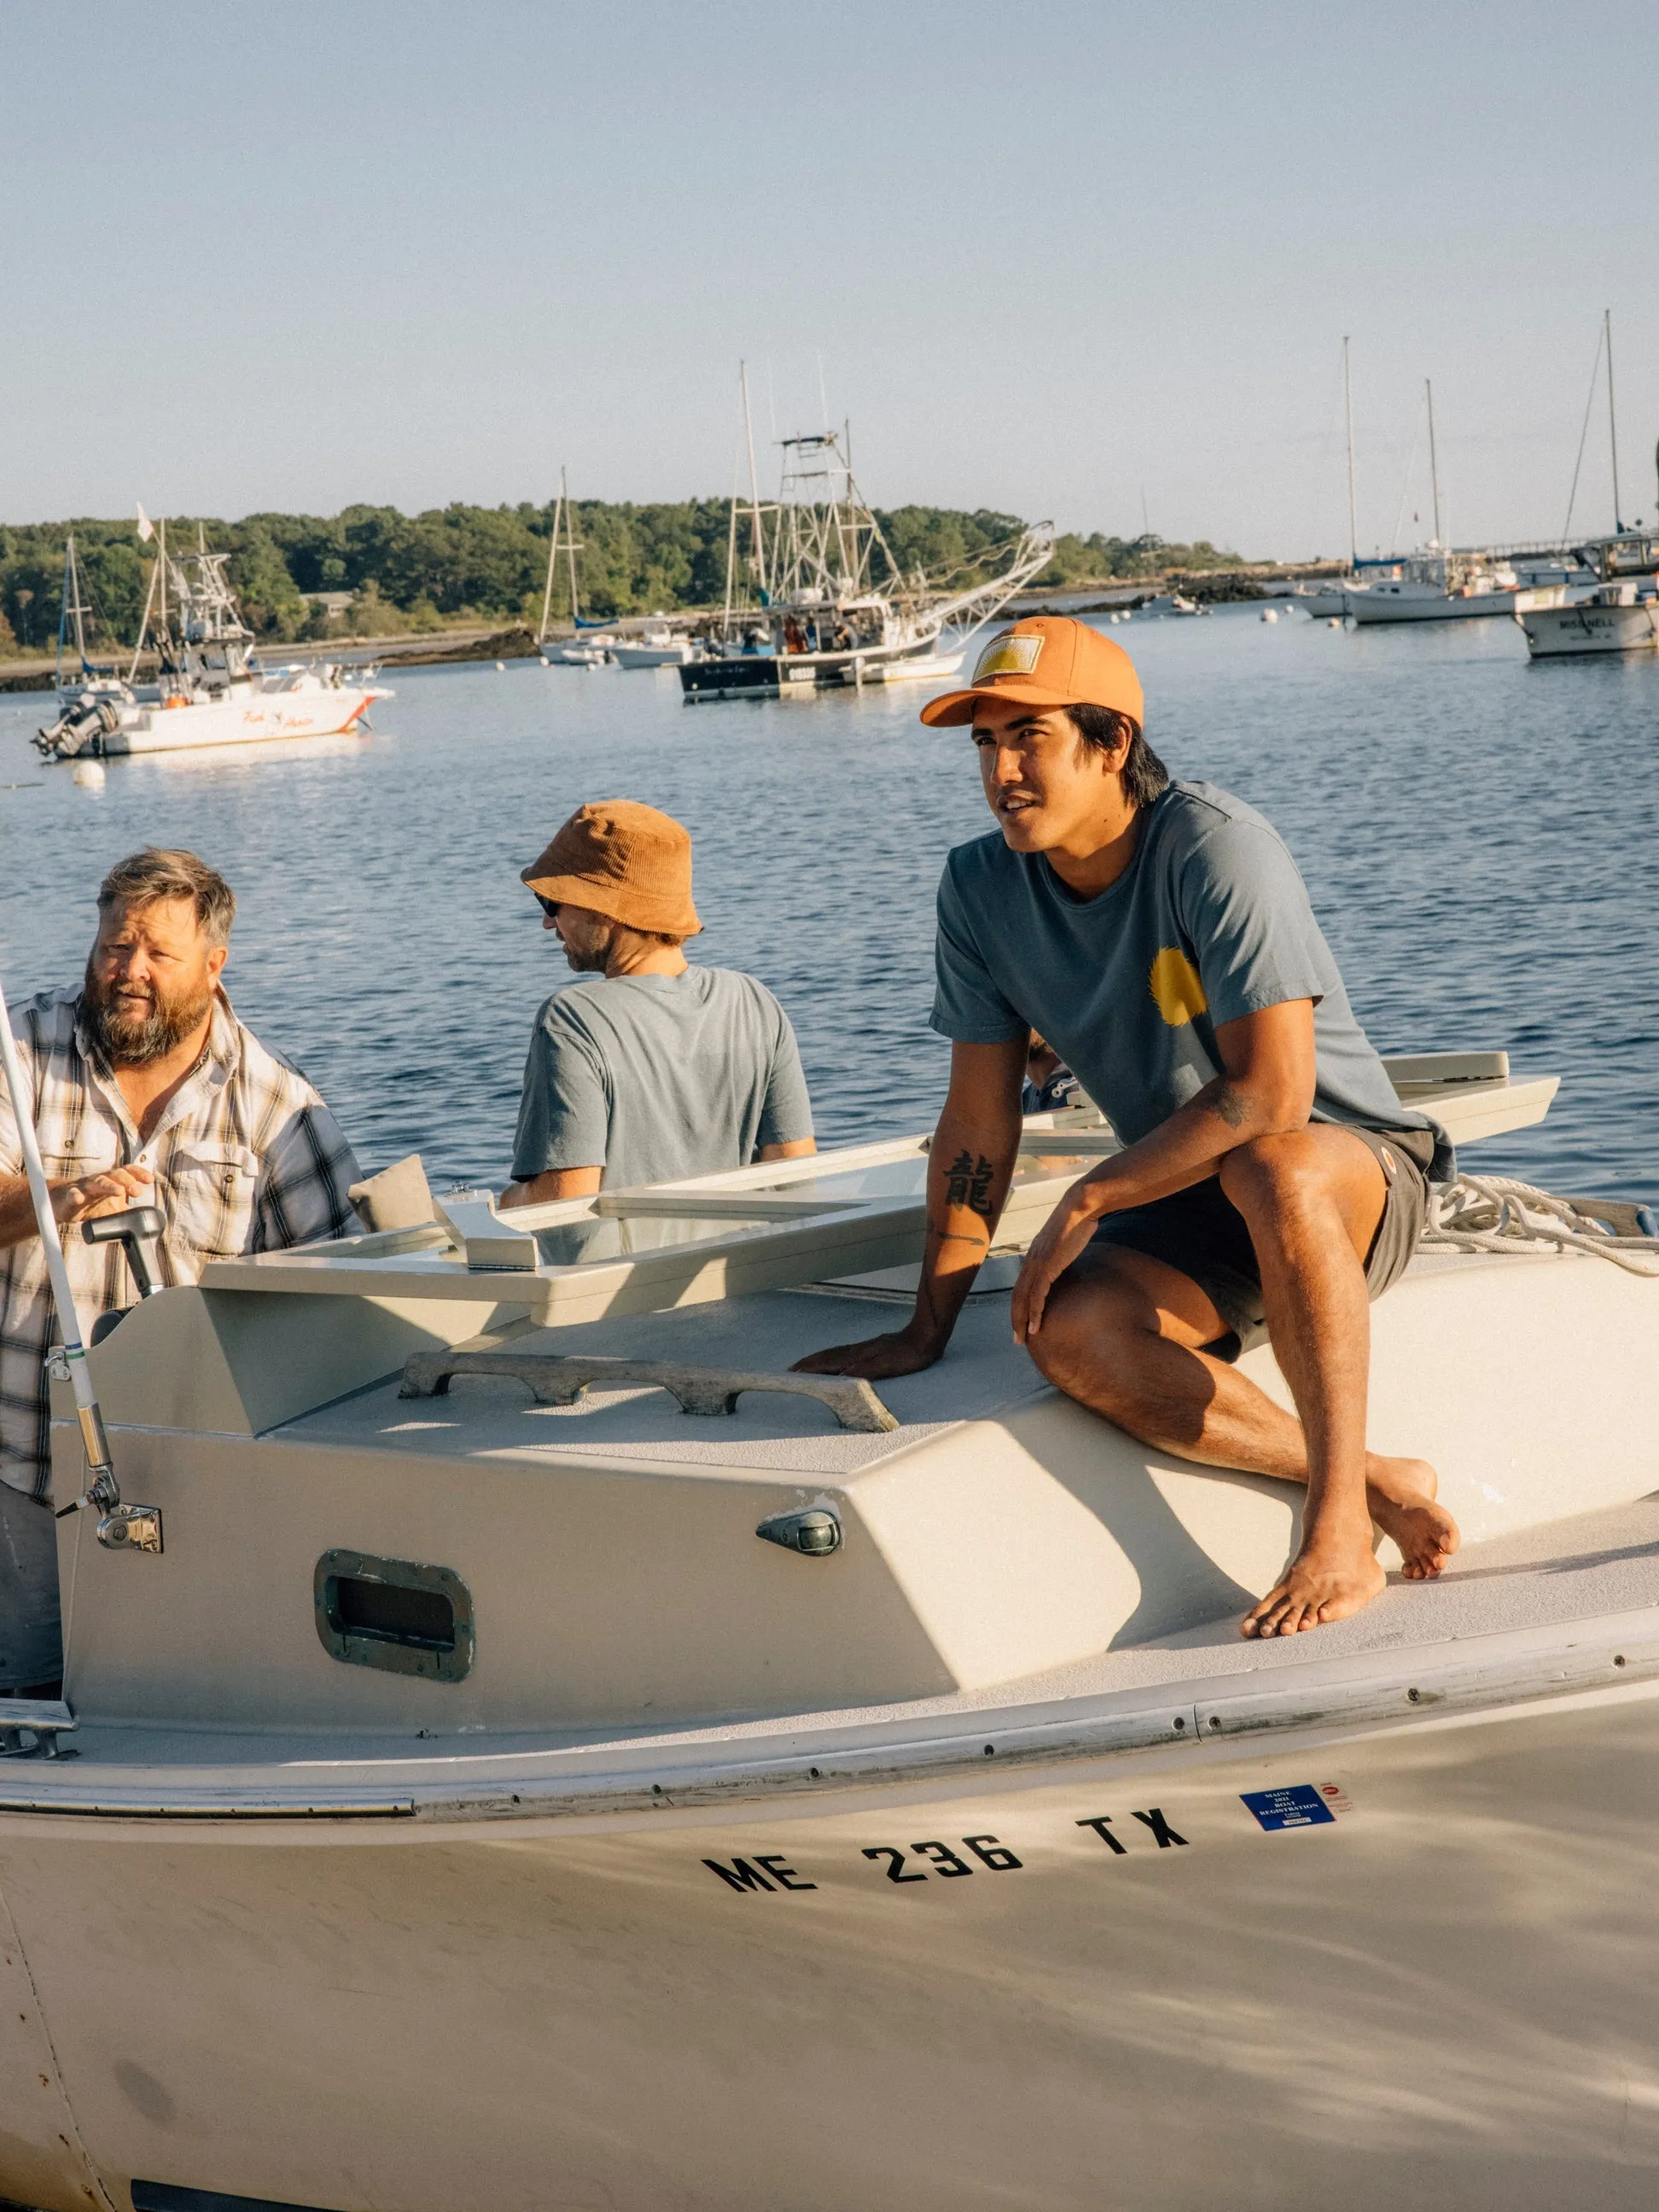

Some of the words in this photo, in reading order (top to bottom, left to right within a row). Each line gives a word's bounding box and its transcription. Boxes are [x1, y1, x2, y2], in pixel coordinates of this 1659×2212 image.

[1265, 1790, 1292, 1799] MAINE
[1259, 1802, 1318, 1816] REGISTRATION
[701, 1855, 818, 1892] ME
[862, 1836, 1022, 1883] 236
[1076, 1808, 1189, 1854] TX
